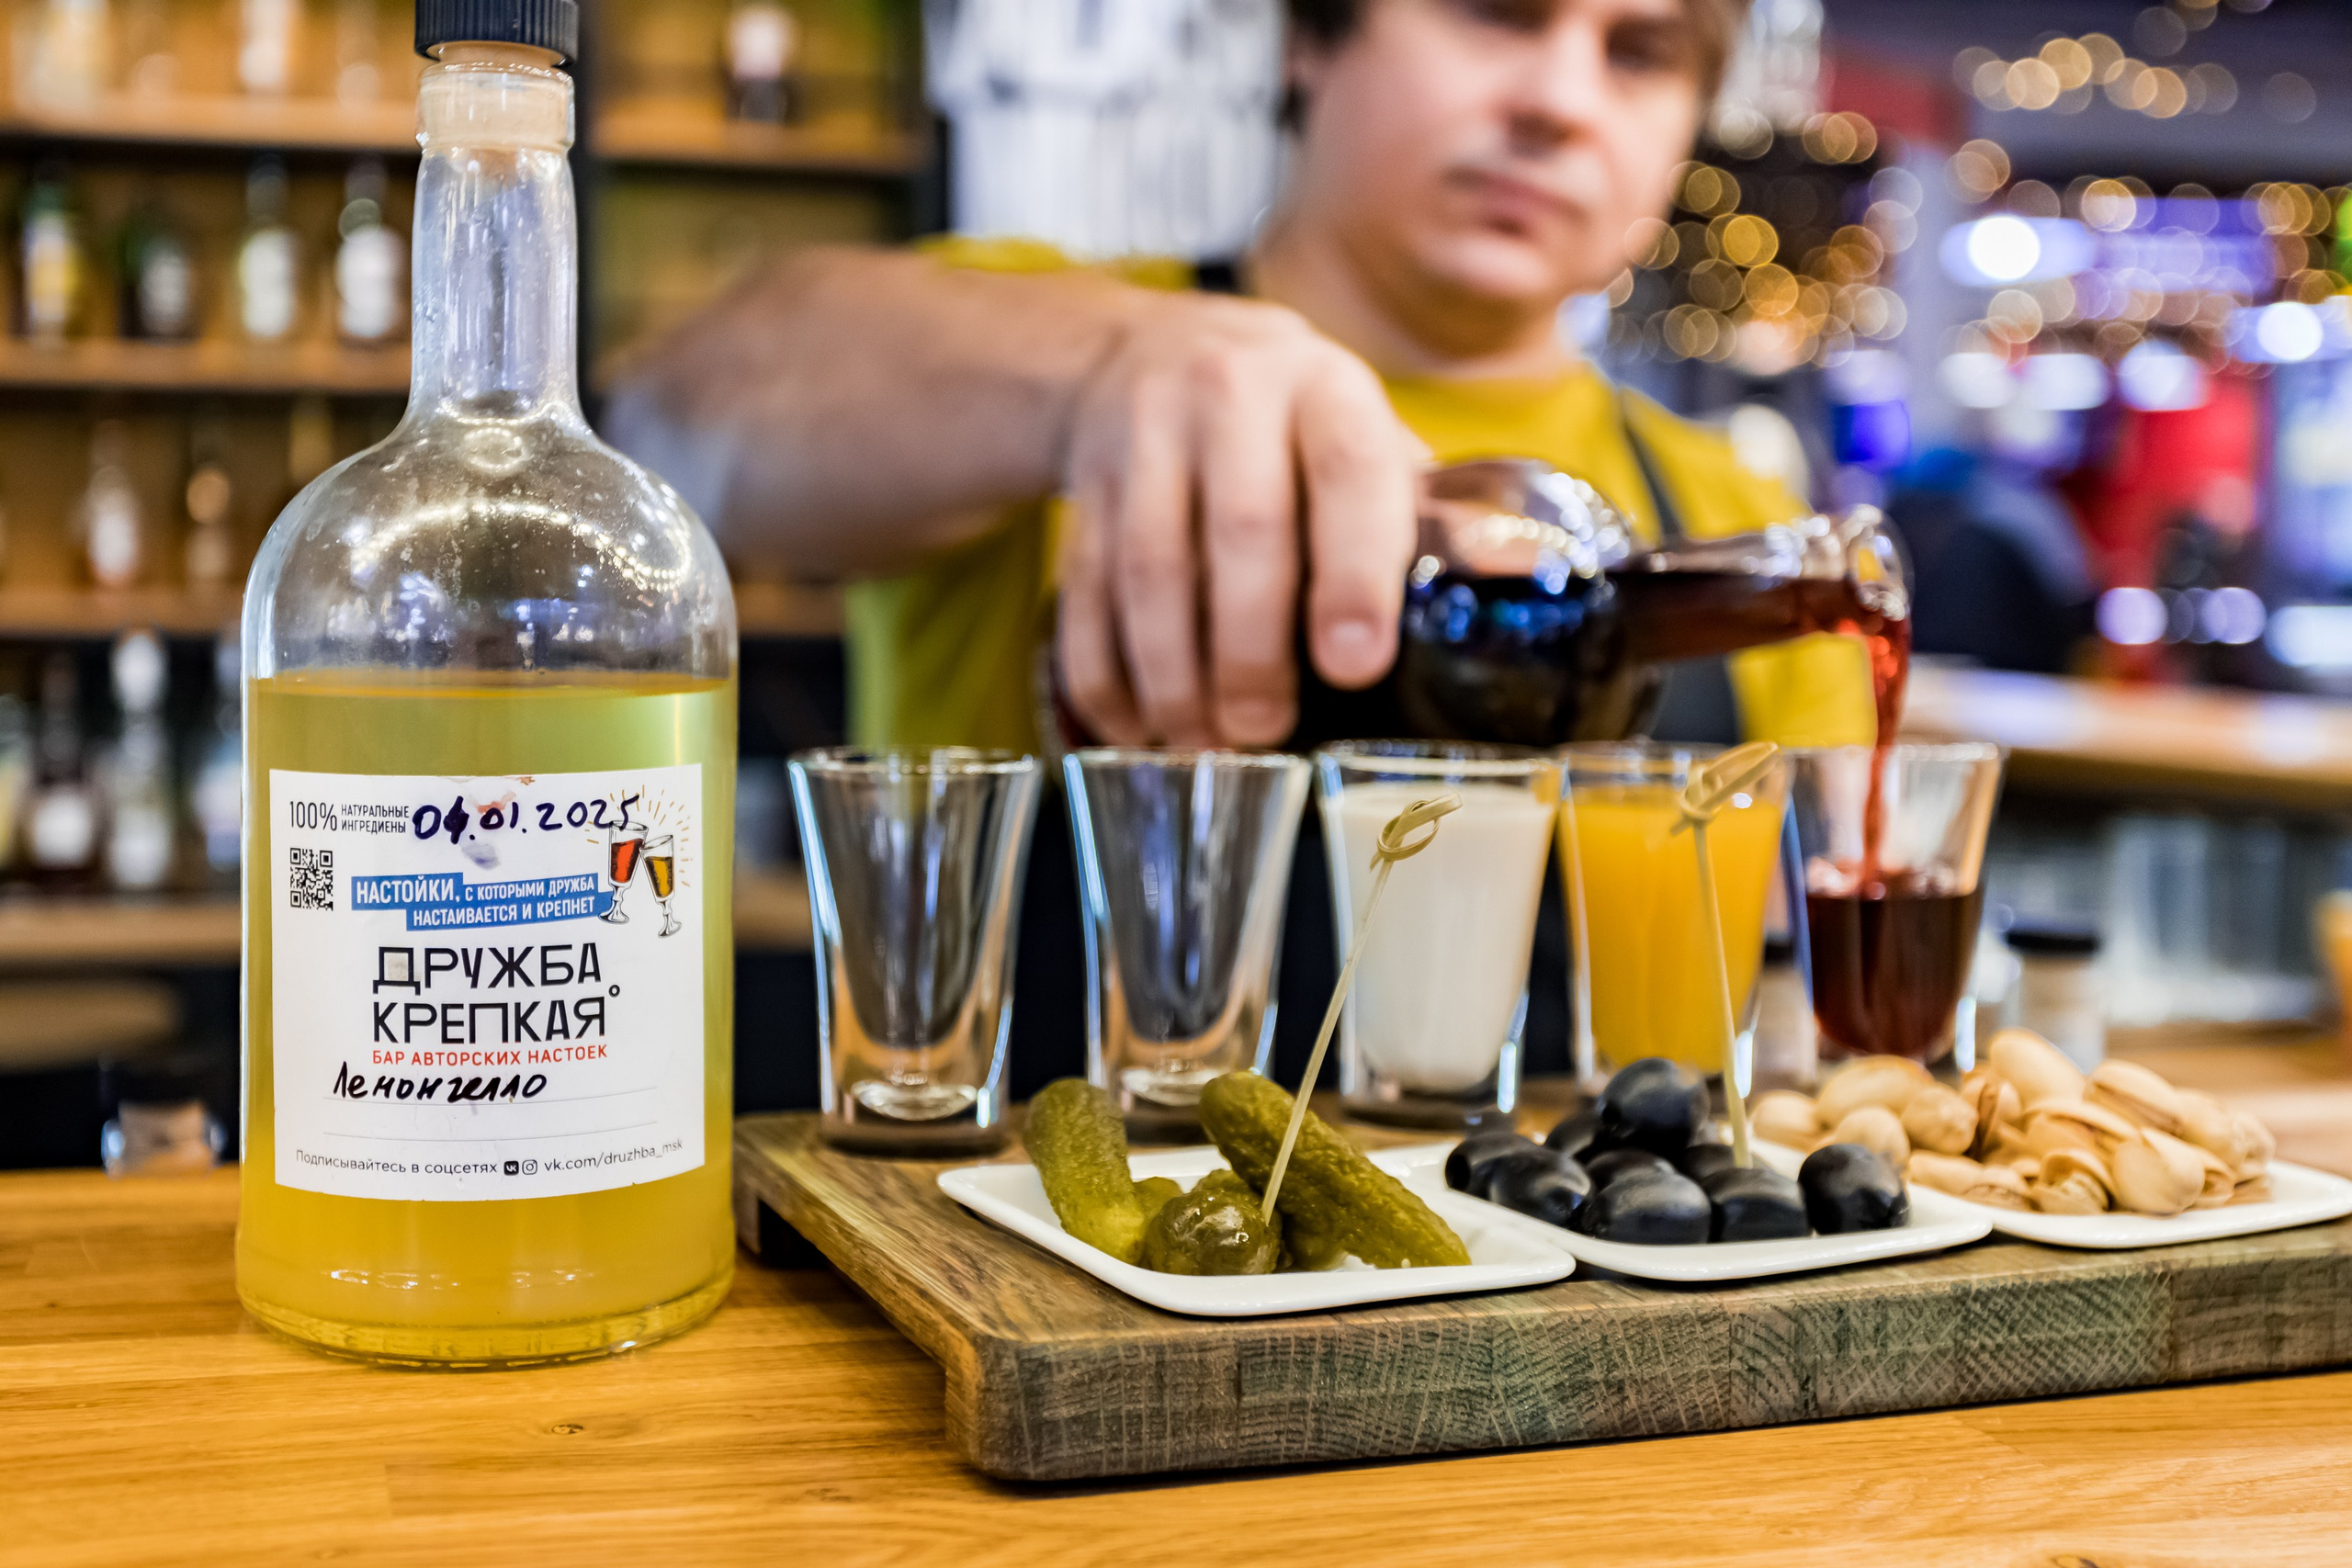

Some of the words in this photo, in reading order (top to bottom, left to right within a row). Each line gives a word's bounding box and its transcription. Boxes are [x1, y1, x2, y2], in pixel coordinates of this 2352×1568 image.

[289, 800, 337, 831] 100%
[341, 804, 410, 818] НАТУРАЛЬНЫЕ
[356, 875, 460, 904] НАСТОЙКИ,
[477, 882, 545, 900] КОТОРЫМИ
[548, 876, 595, 897] ДРУЖБА
[413, 906, 518, 927] НАСТАИВАЕТСЯ
[522, 904, 532, 919] И
[537, 897, 595, 919] КРЕПНЕТ
[372, 942, 603, 996] ДРУЖБА
[372, 1050, 405, 1066] БАР
[411, 1051, 521, 1066] АВТОРСКИХ
[527, 1044, 607, 1064] НАСТОЕК
[296, 1150, 406, 1173] Подписывайтесь
[412, 1164, 420, 1173] в
[424, 1163, 498, 1175] соцсетях
[544, 1139, 683, 1171] vk.com/druzhba_msk
